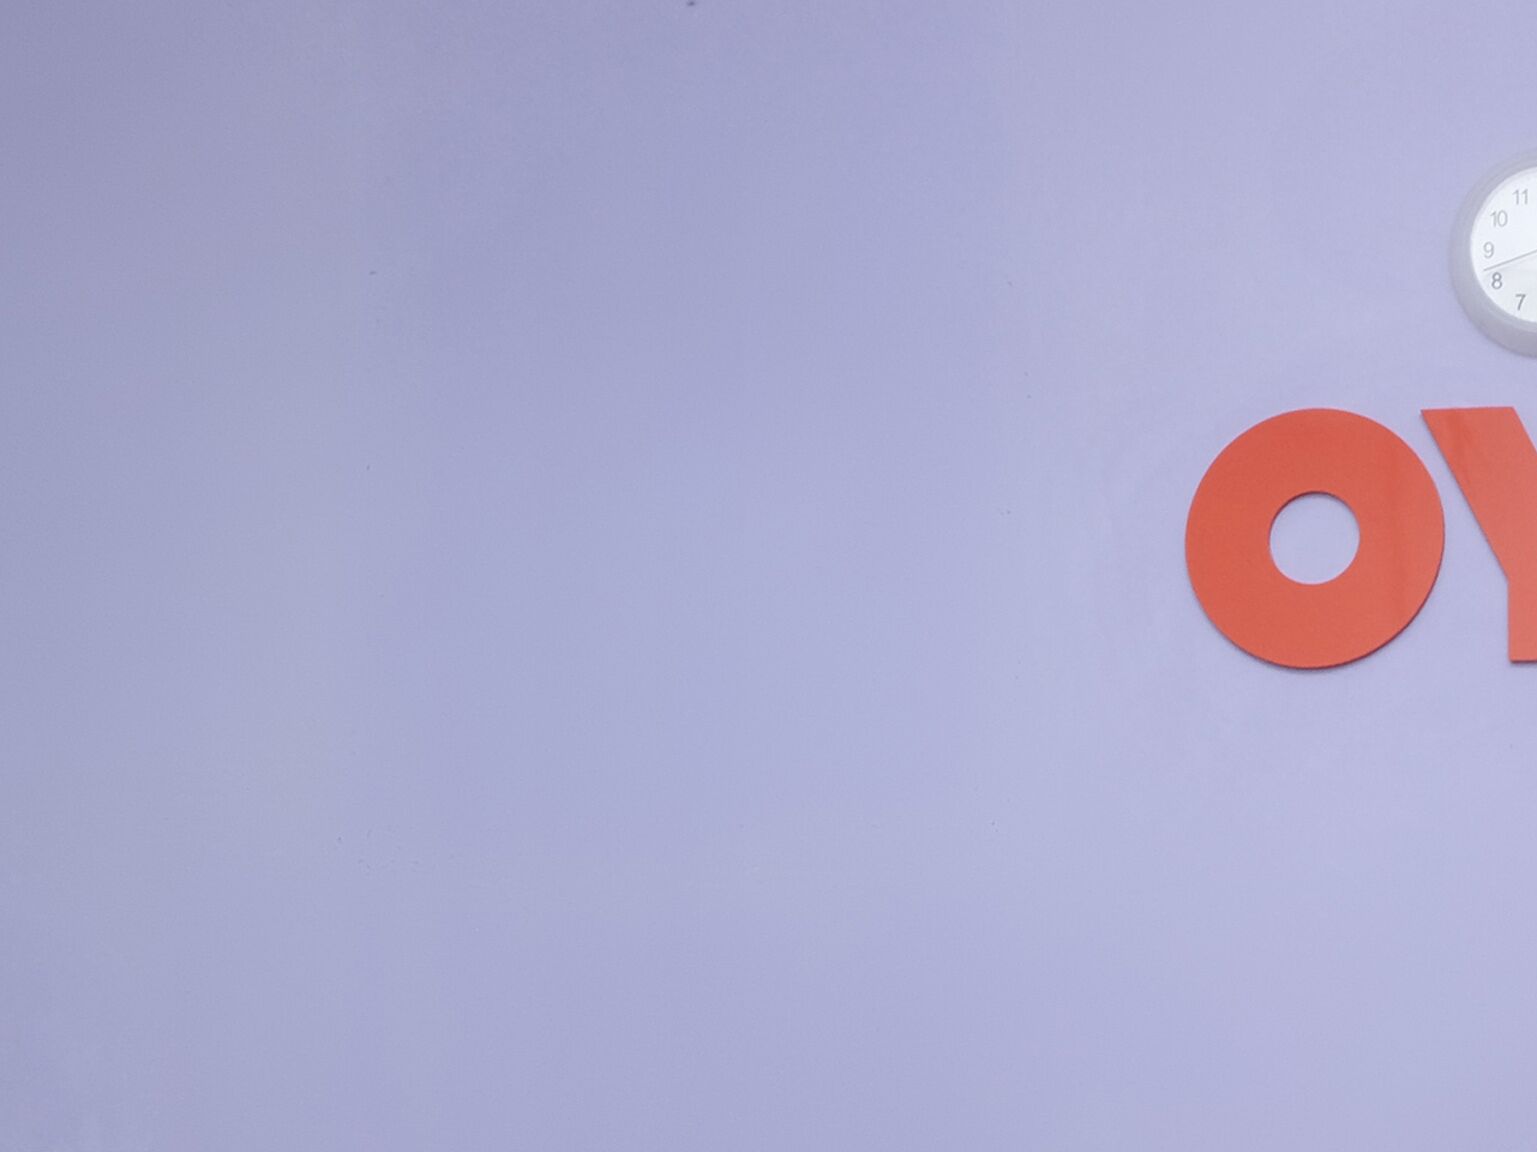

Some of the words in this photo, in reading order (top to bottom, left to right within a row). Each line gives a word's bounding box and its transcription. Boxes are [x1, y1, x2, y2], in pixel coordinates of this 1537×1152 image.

[1511, 188, 1529, 205] 11
[1489, 209, 1509, 228] 10
[1482, 241, 1495, 259] 9
[1490, 272, 1503, 290] 8
[1515, 293, 1527, 311] 7
